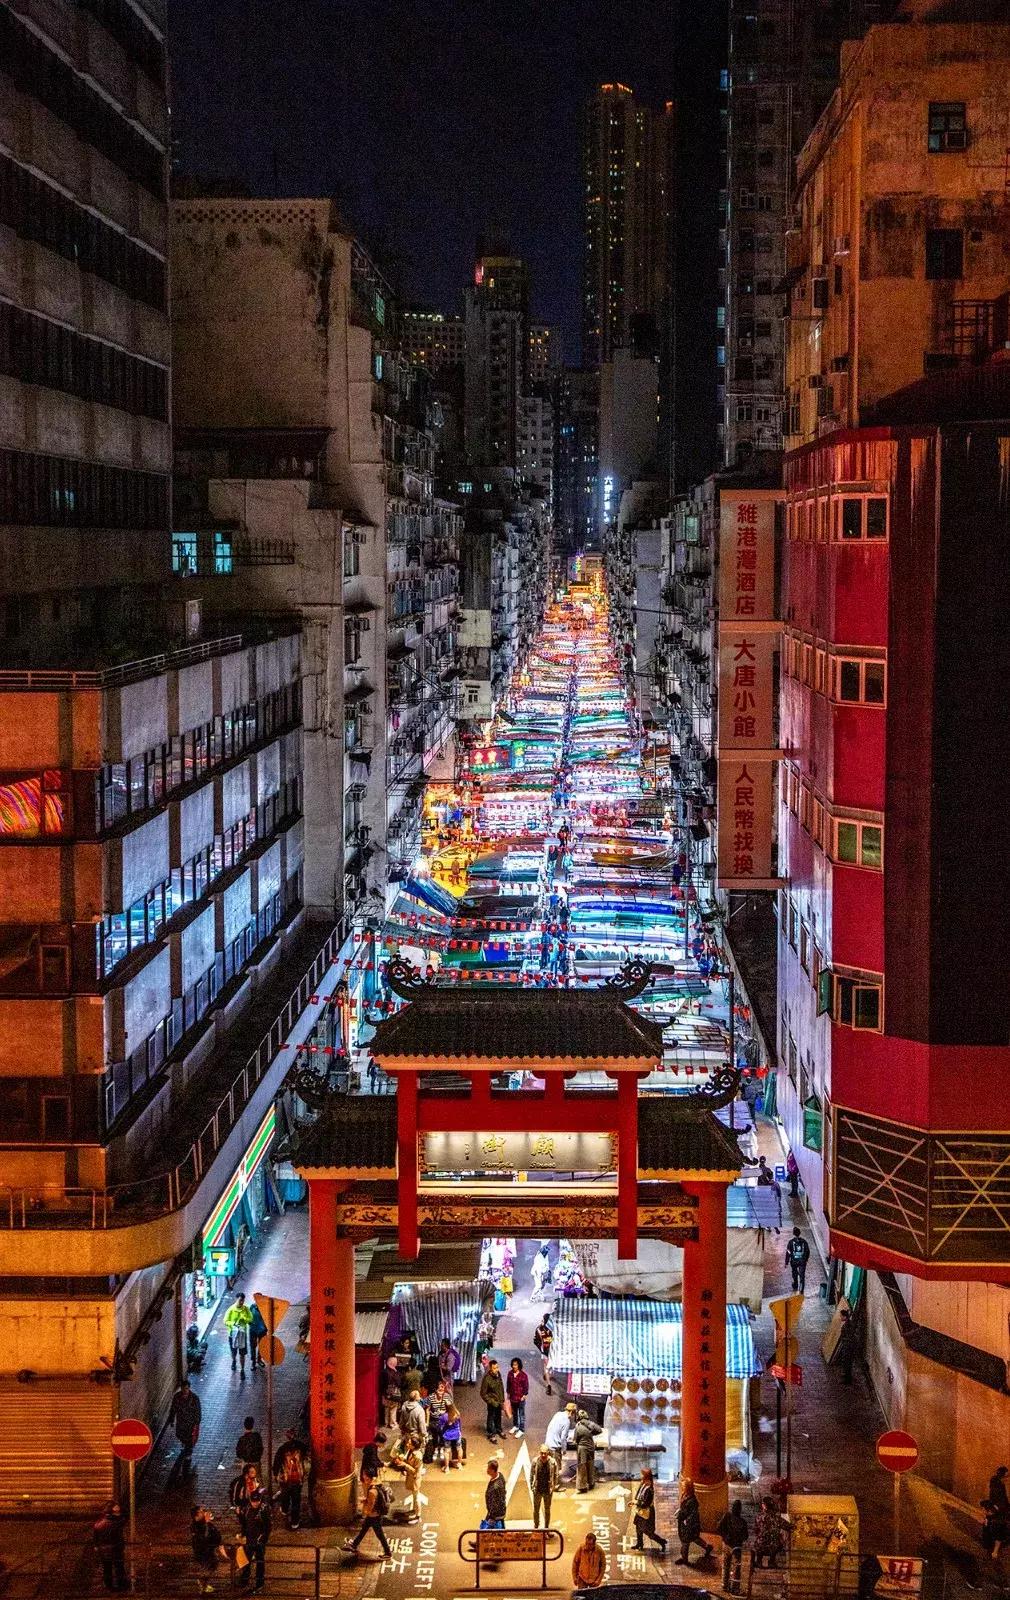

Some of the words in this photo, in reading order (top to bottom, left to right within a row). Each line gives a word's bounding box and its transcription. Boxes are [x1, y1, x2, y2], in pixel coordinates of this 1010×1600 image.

[735, 503, 758, 616] 維港灣酒店
[733, 639, 757, 739] 大唐小館
[733, 763, 756, 876] 人民幣找換
[413, 1560, 435, 1590] LEFT
[419, 1521, 440, 1557] LOOK
